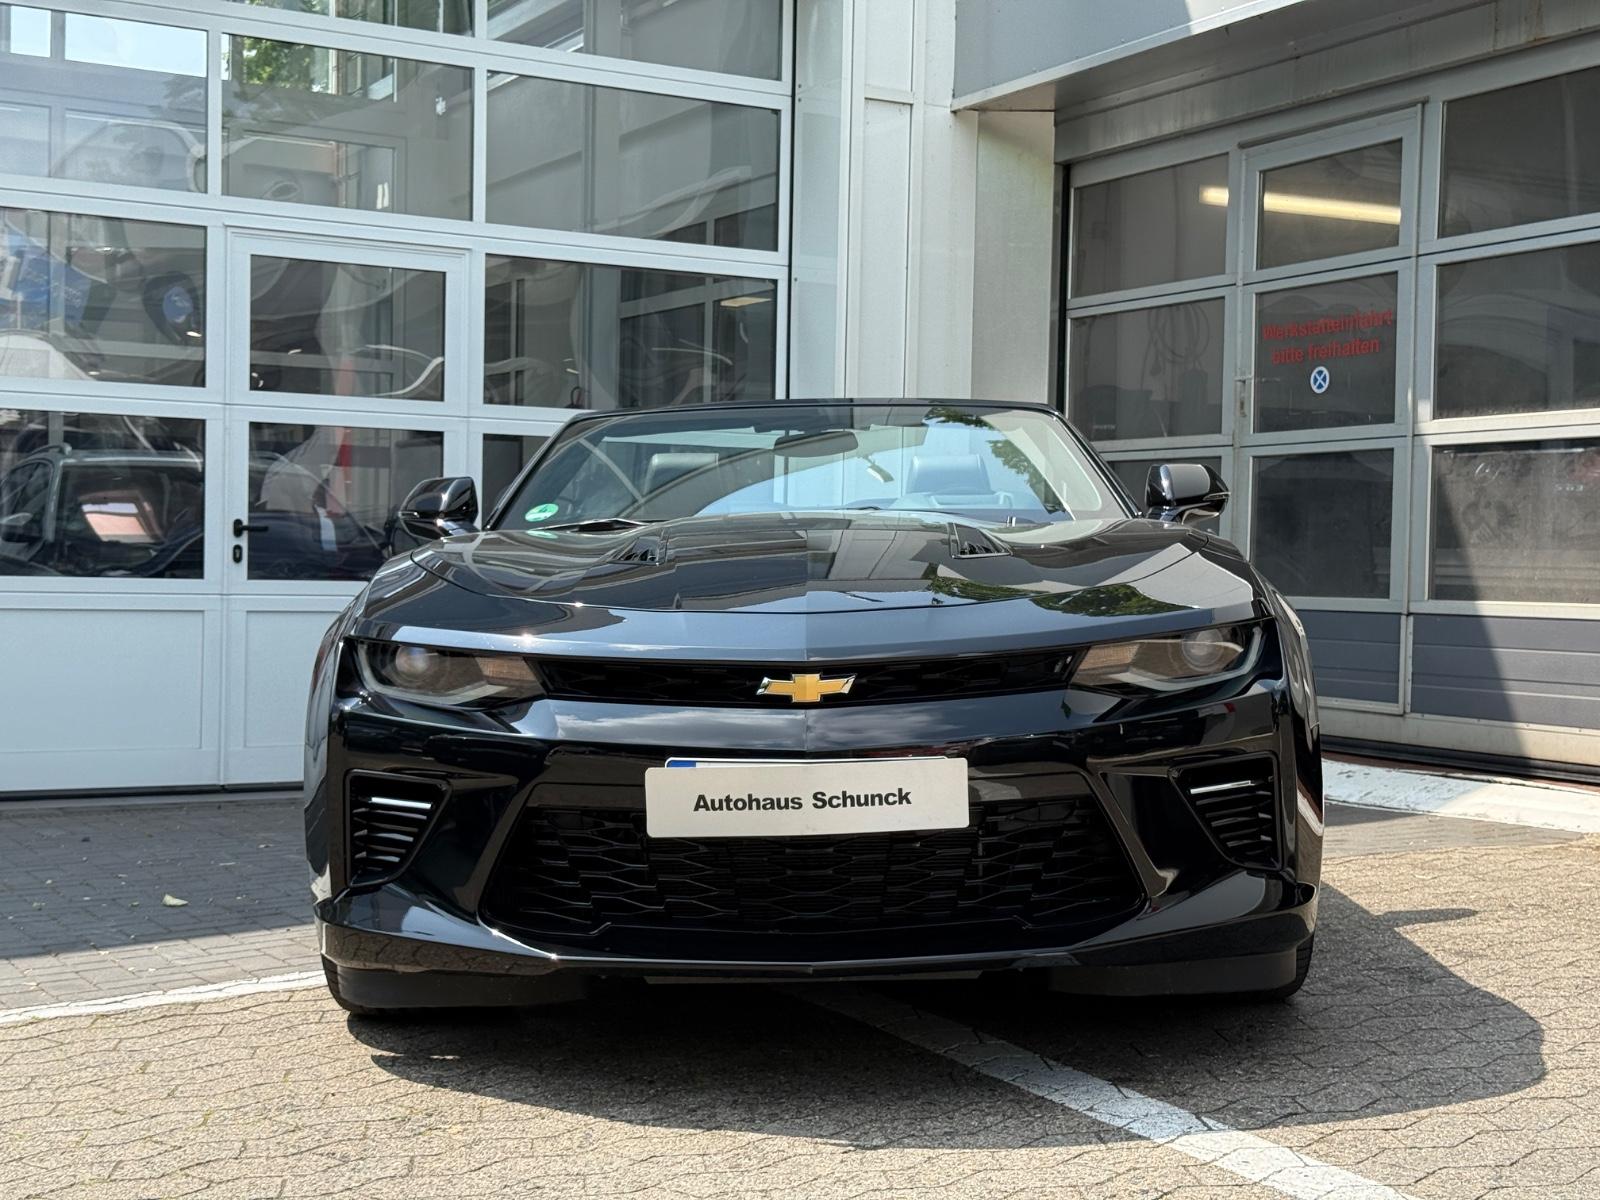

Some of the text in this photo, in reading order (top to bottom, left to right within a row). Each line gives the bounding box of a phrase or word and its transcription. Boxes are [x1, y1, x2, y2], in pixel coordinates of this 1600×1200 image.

[1308, 337, 1380, 361] freihalten
[693, 787, 912, 812] Autohaus Schunck
